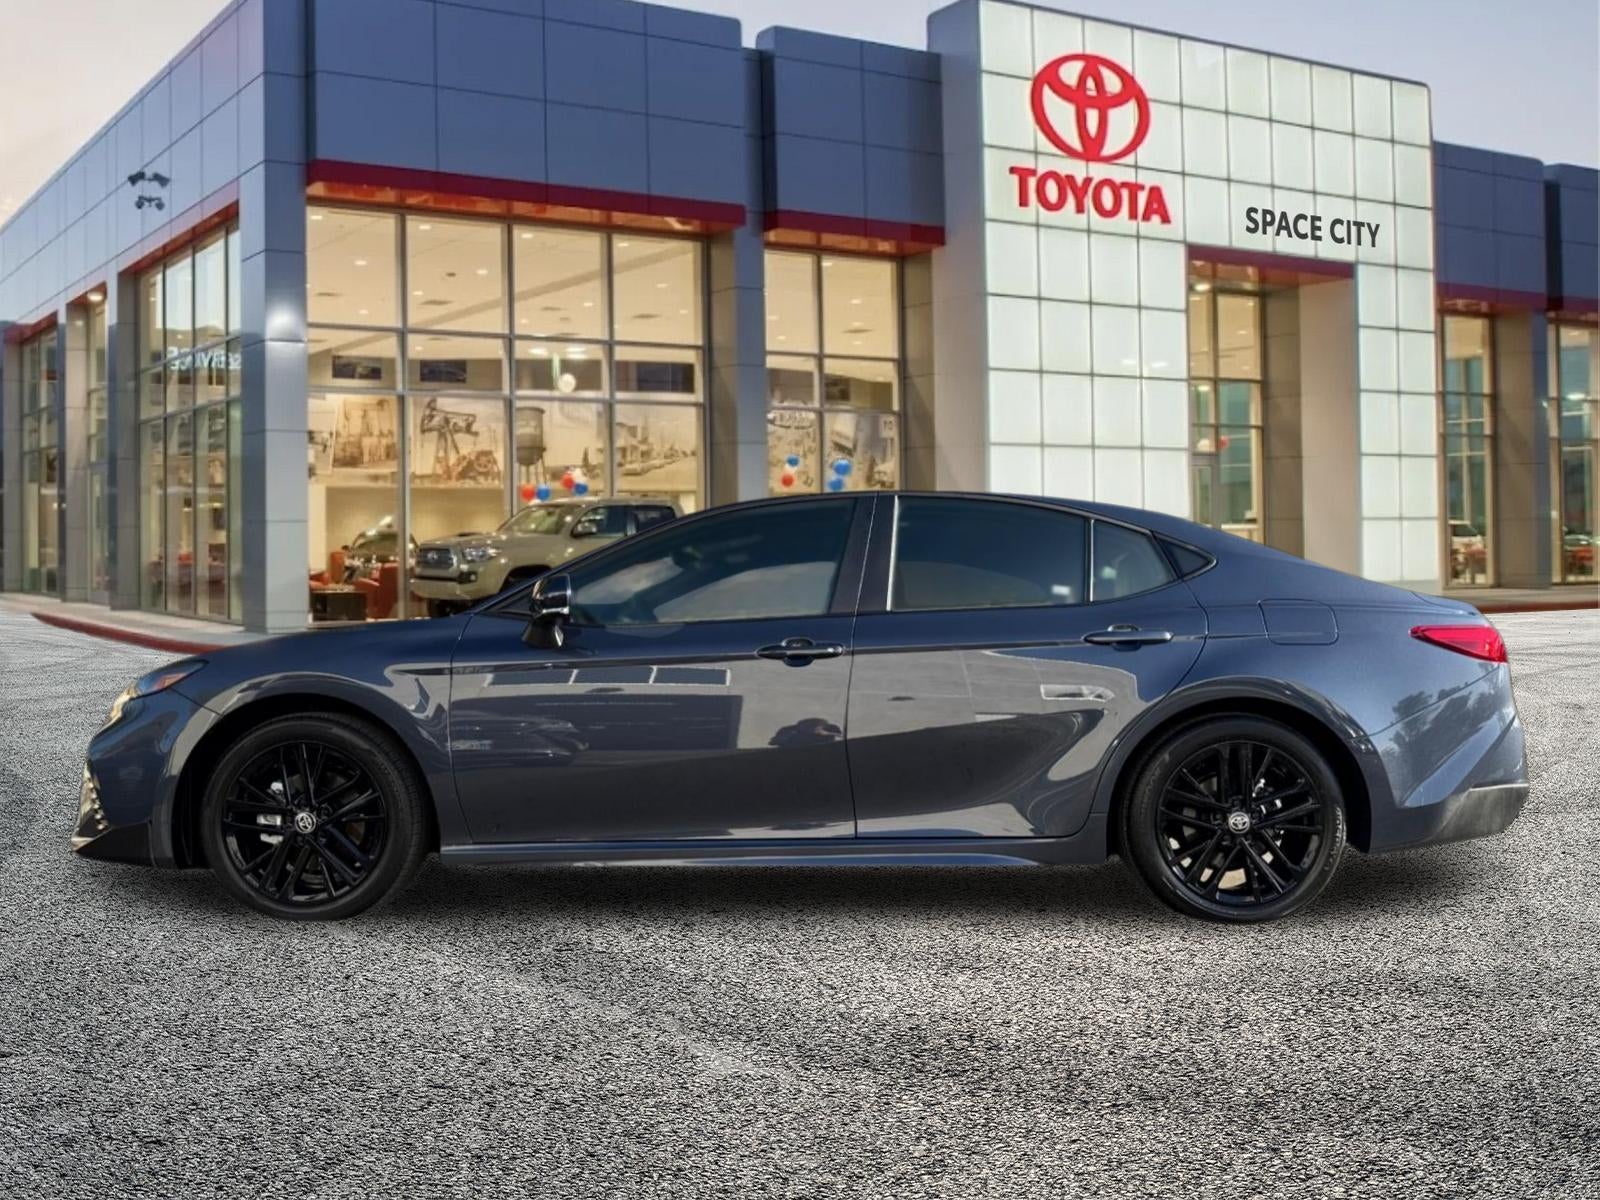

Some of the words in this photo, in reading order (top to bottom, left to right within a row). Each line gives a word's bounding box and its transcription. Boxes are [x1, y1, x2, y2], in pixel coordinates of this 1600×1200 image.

[1010, 167, 1171, 224] TOYOTA
[1246, 207, 1323, 241] SPACE
[1330, 219, 1380, 247] CITY
